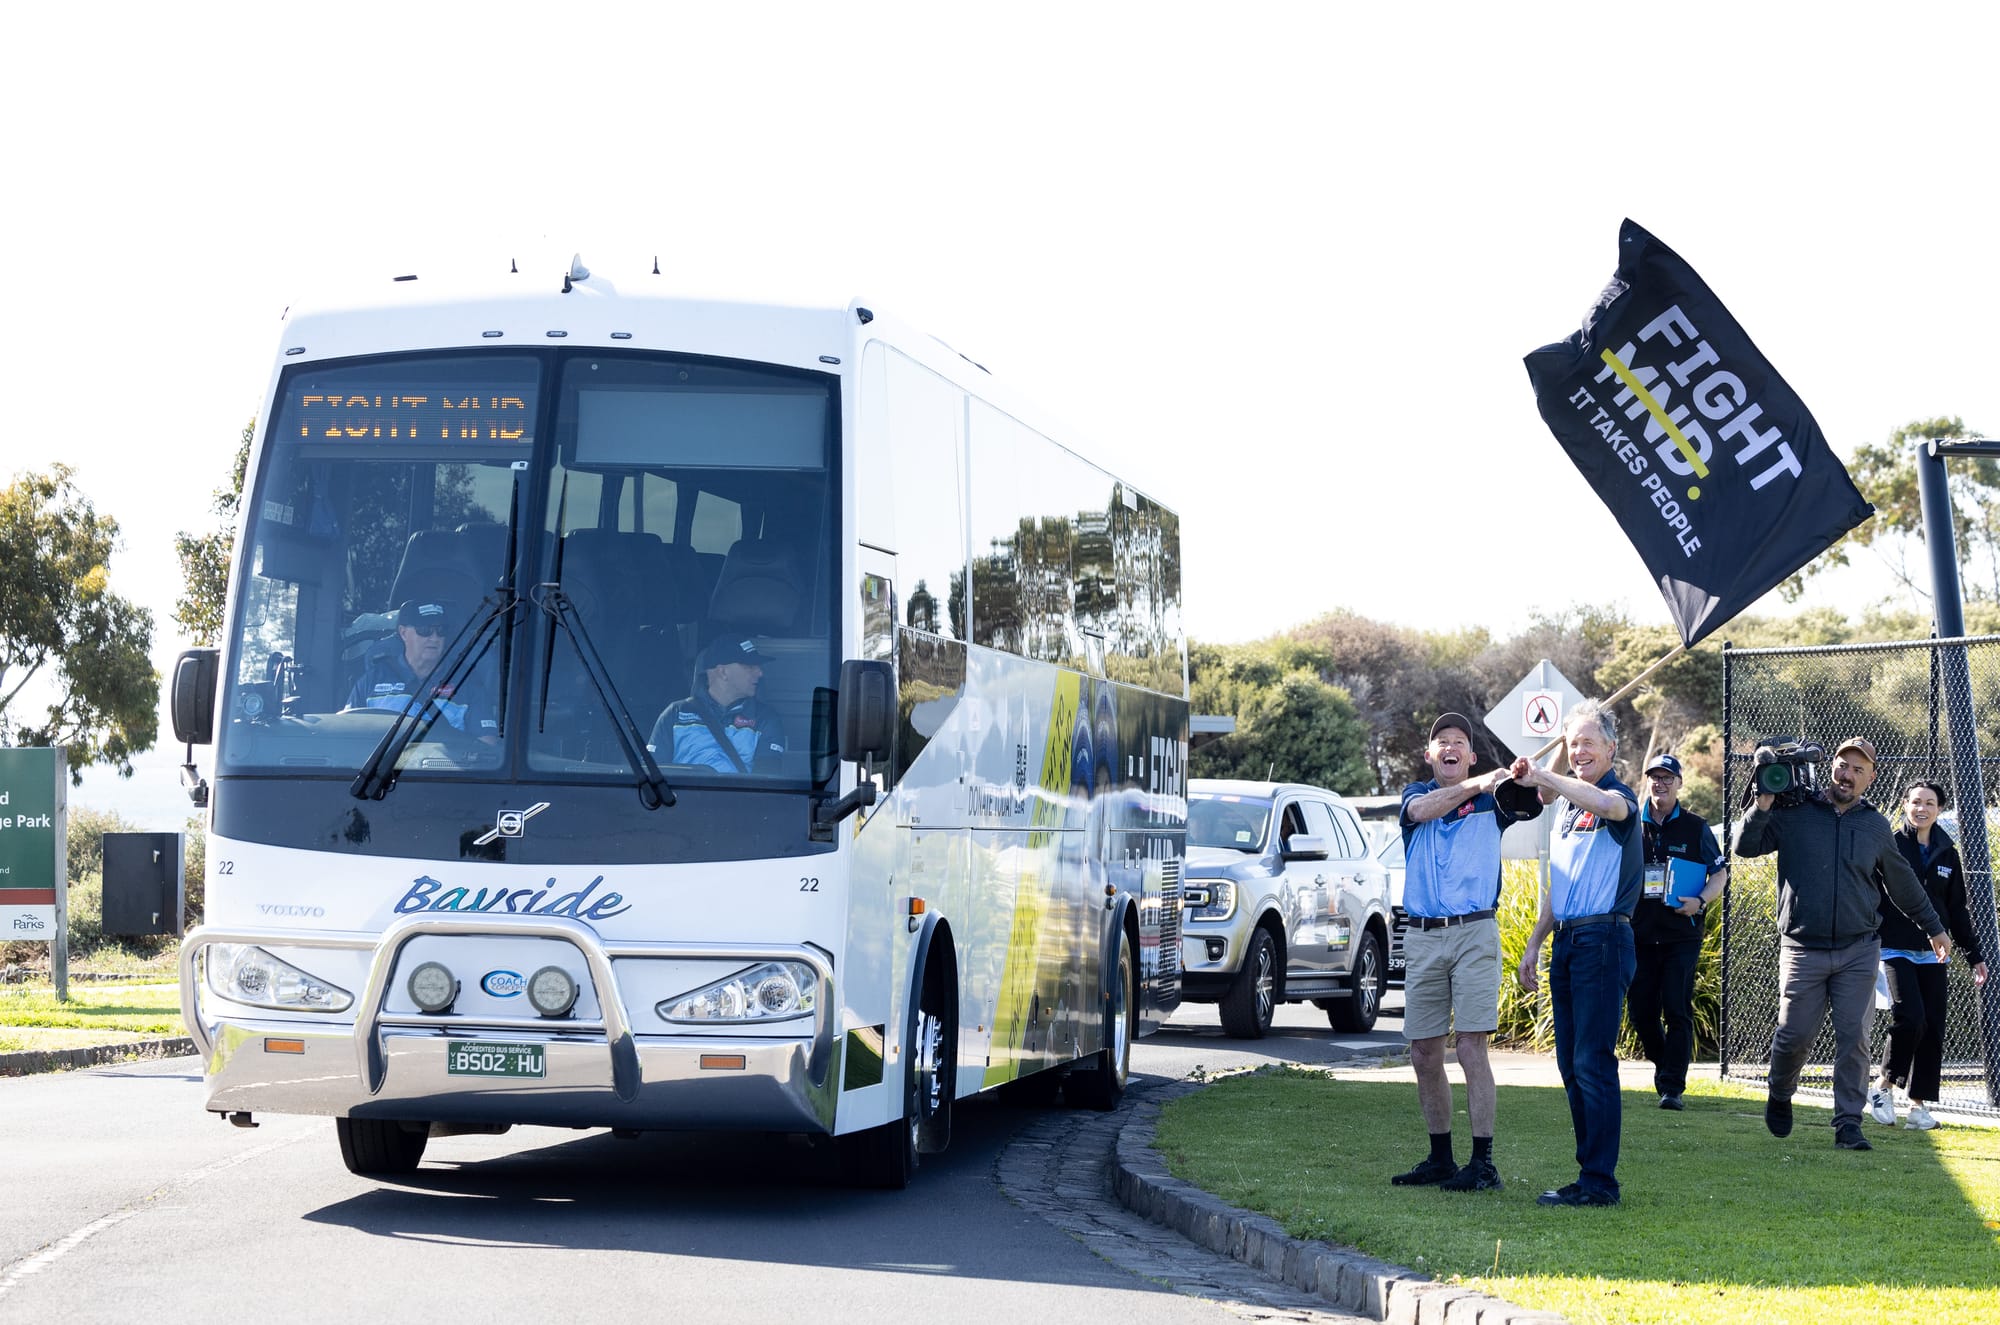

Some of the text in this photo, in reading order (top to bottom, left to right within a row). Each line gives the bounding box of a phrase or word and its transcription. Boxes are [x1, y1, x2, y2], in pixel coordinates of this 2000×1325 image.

[1637, 304, 1803, 491] FIGHT
[301, 395, 428, 438] FIGHT
[1568, 386, 1702, 558] IT TAKES PEOPLE
[1149, 735, 1189, 825] FIGHT
[17, 813, 51, 828] Park
[219, 860, 234, 875] 22
[800, 877, 819, 892] 22
[393, 875, 632, 921] Bayside
[257, 903, 325, 918] VOLVO
[13, 919, 45, 929] Parks
[490, 976, 528, 987] COACH
[460, 1045, 496, 1054] ACCREDITED
[517, 1054, 543, 1073] HU
